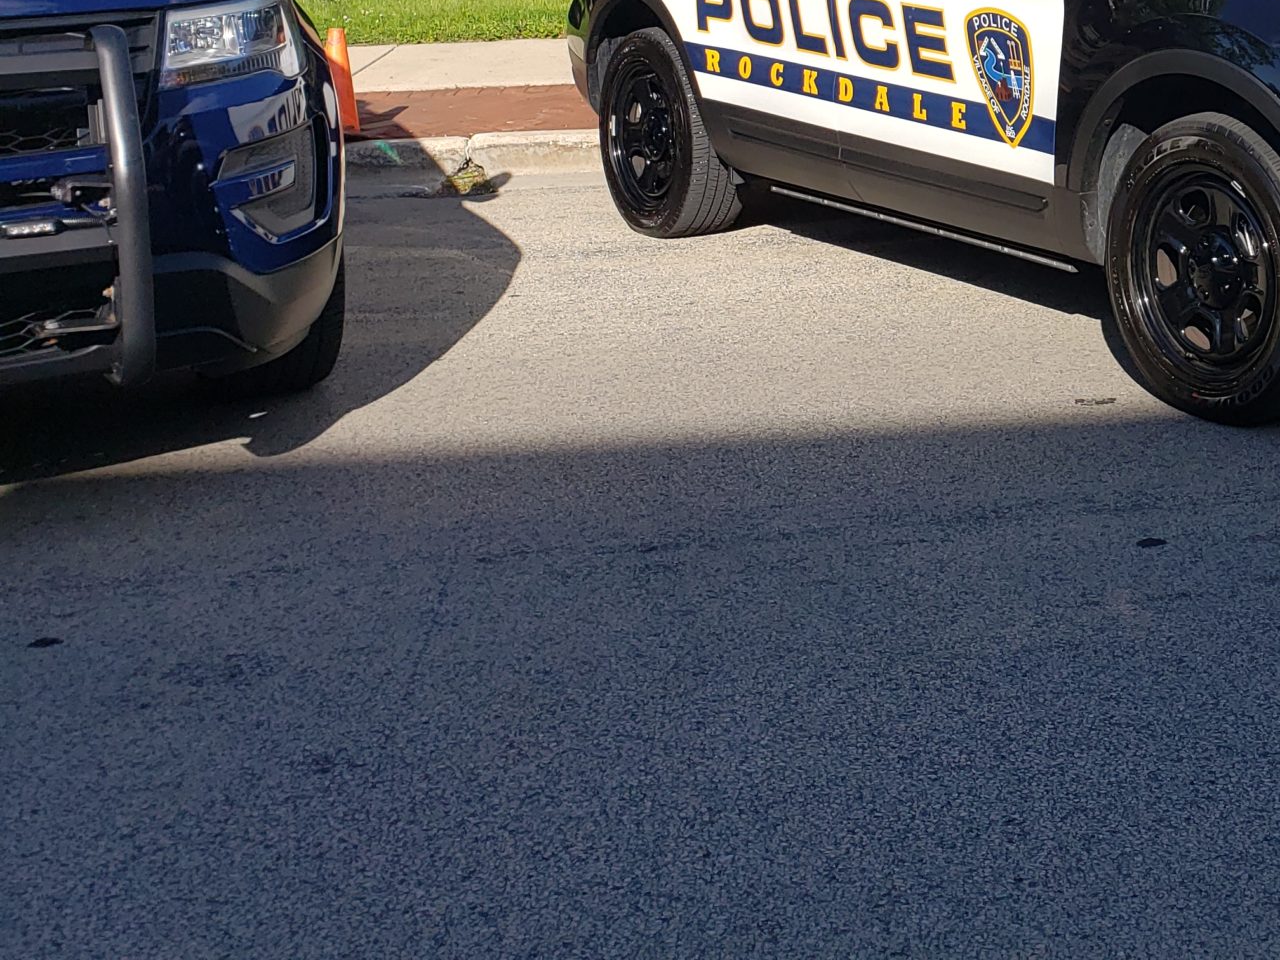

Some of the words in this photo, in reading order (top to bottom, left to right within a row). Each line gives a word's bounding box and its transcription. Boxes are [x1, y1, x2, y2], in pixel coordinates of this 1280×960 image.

[972, 12, 1020, 38] POLICE
[706, 48, 967, 131] ROCKDALE
[972, 54, 993, 100] VILLAGE
[990, 97, 1001, 115] OF
[1020, 64, 1031, 121] ROCKDALE
